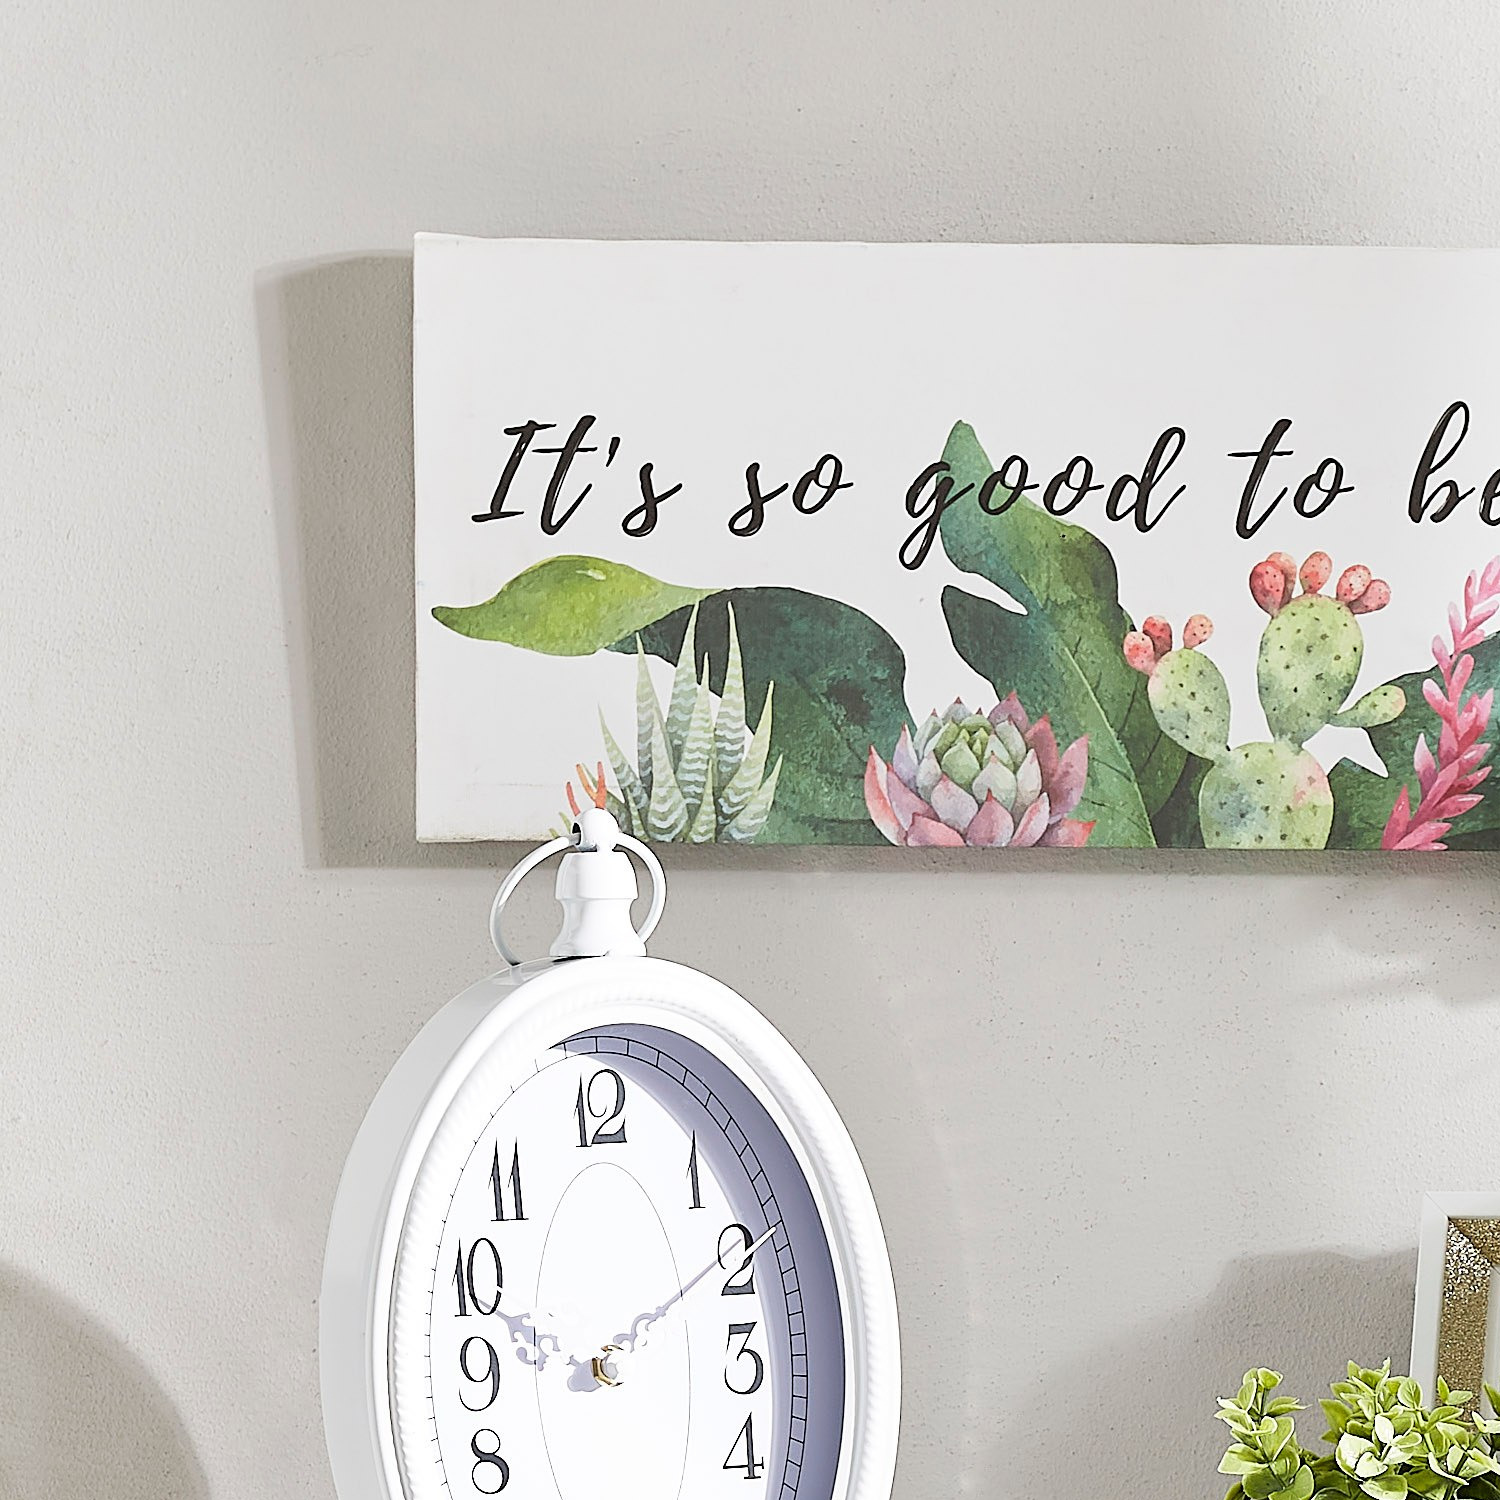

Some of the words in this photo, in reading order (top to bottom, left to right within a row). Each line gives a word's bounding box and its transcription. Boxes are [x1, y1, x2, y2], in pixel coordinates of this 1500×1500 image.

[471, 414, 682, 538] It's
[728, 453, 853, 537] so
[899, 426, 1187, 570] good
[1227, 418, 1355, 540] to
[575, 1068, 627, 1148] 12
[488, 1137, 529, 1222] 11
[686, 1129, 706, 1210] 1
[452, 1236, 503, 1318] 10
[716, 1223, 756, 1297] 2
[458, 1336, 500, 1412] 9
[723, 1321, 765, 1395] 3
[471, 1428, 510, 1495] 8
[722, 1411, 765, 1480] 4
